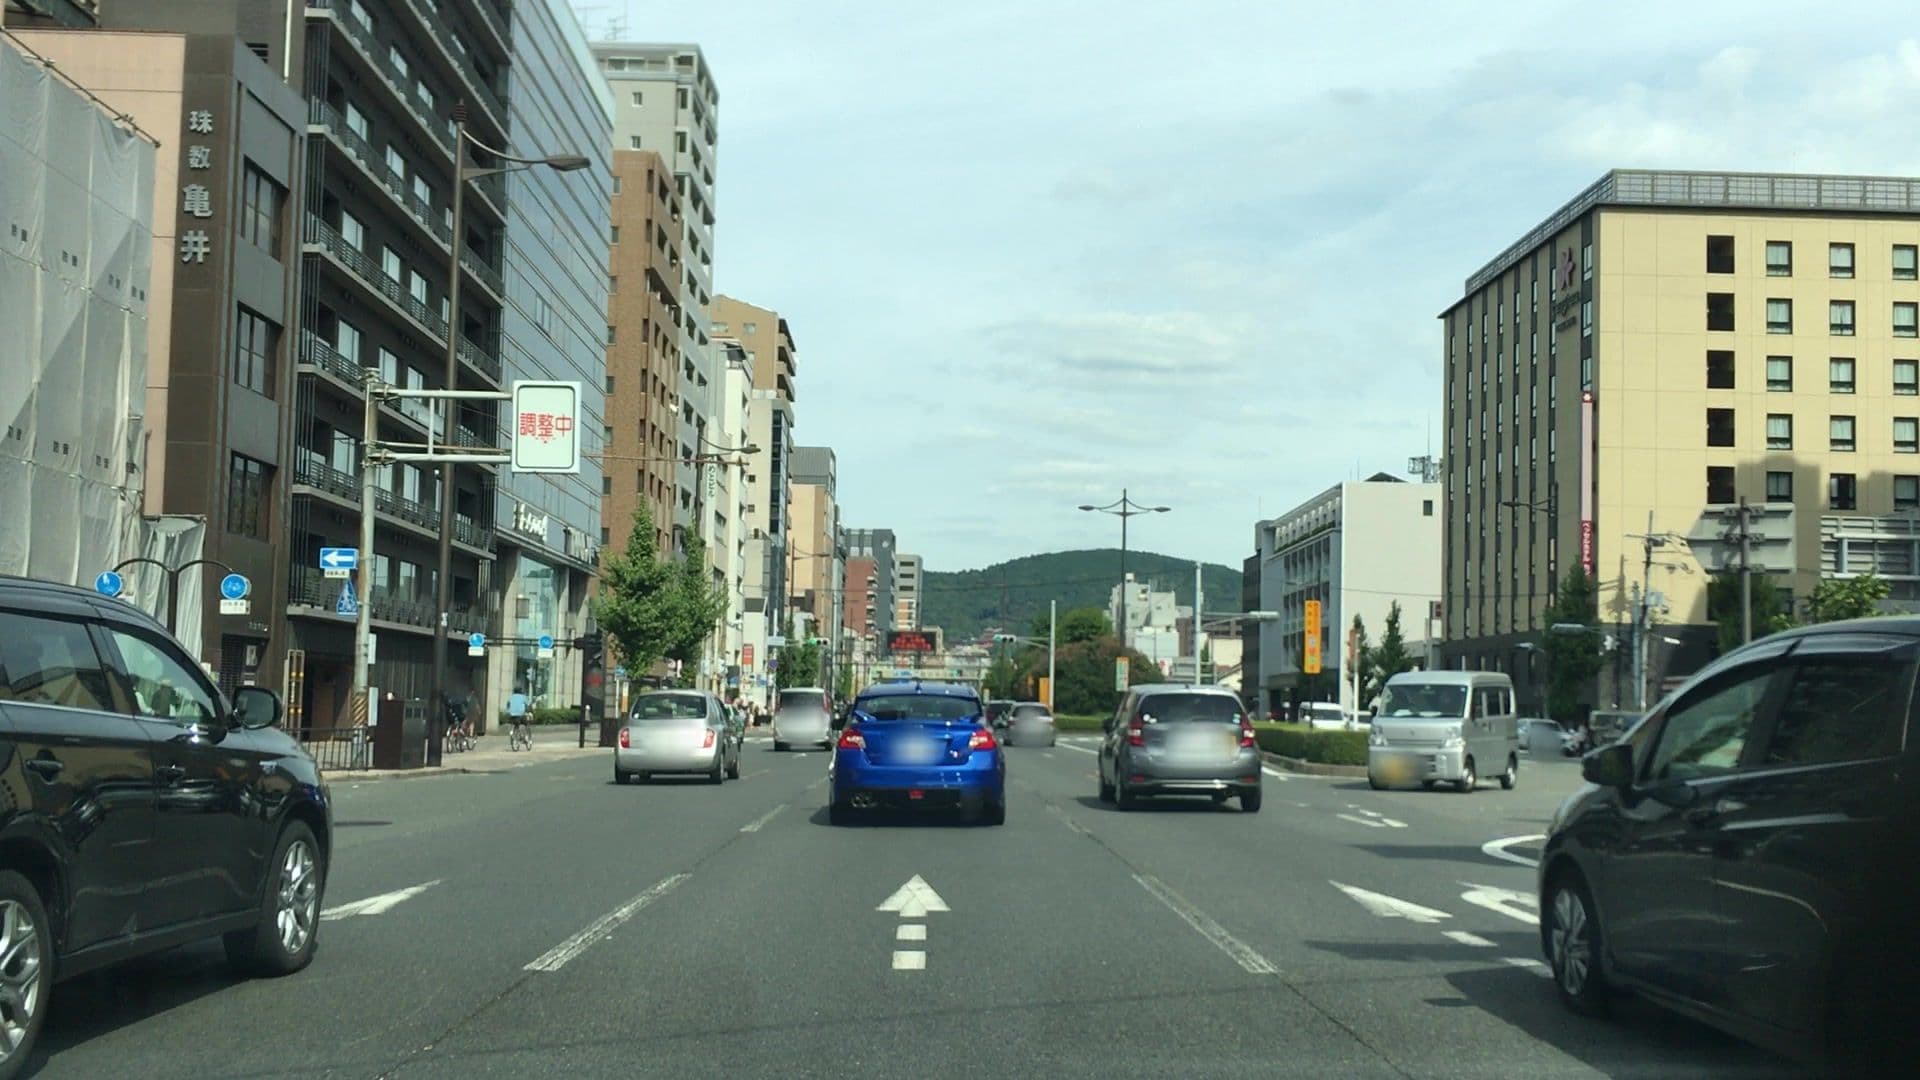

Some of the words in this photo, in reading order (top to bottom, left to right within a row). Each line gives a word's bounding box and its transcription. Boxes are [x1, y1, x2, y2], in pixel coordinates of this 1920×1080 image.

[180, 109, 213, 263] 珠数亀井
[519, 412, 573, 438] 調整中
